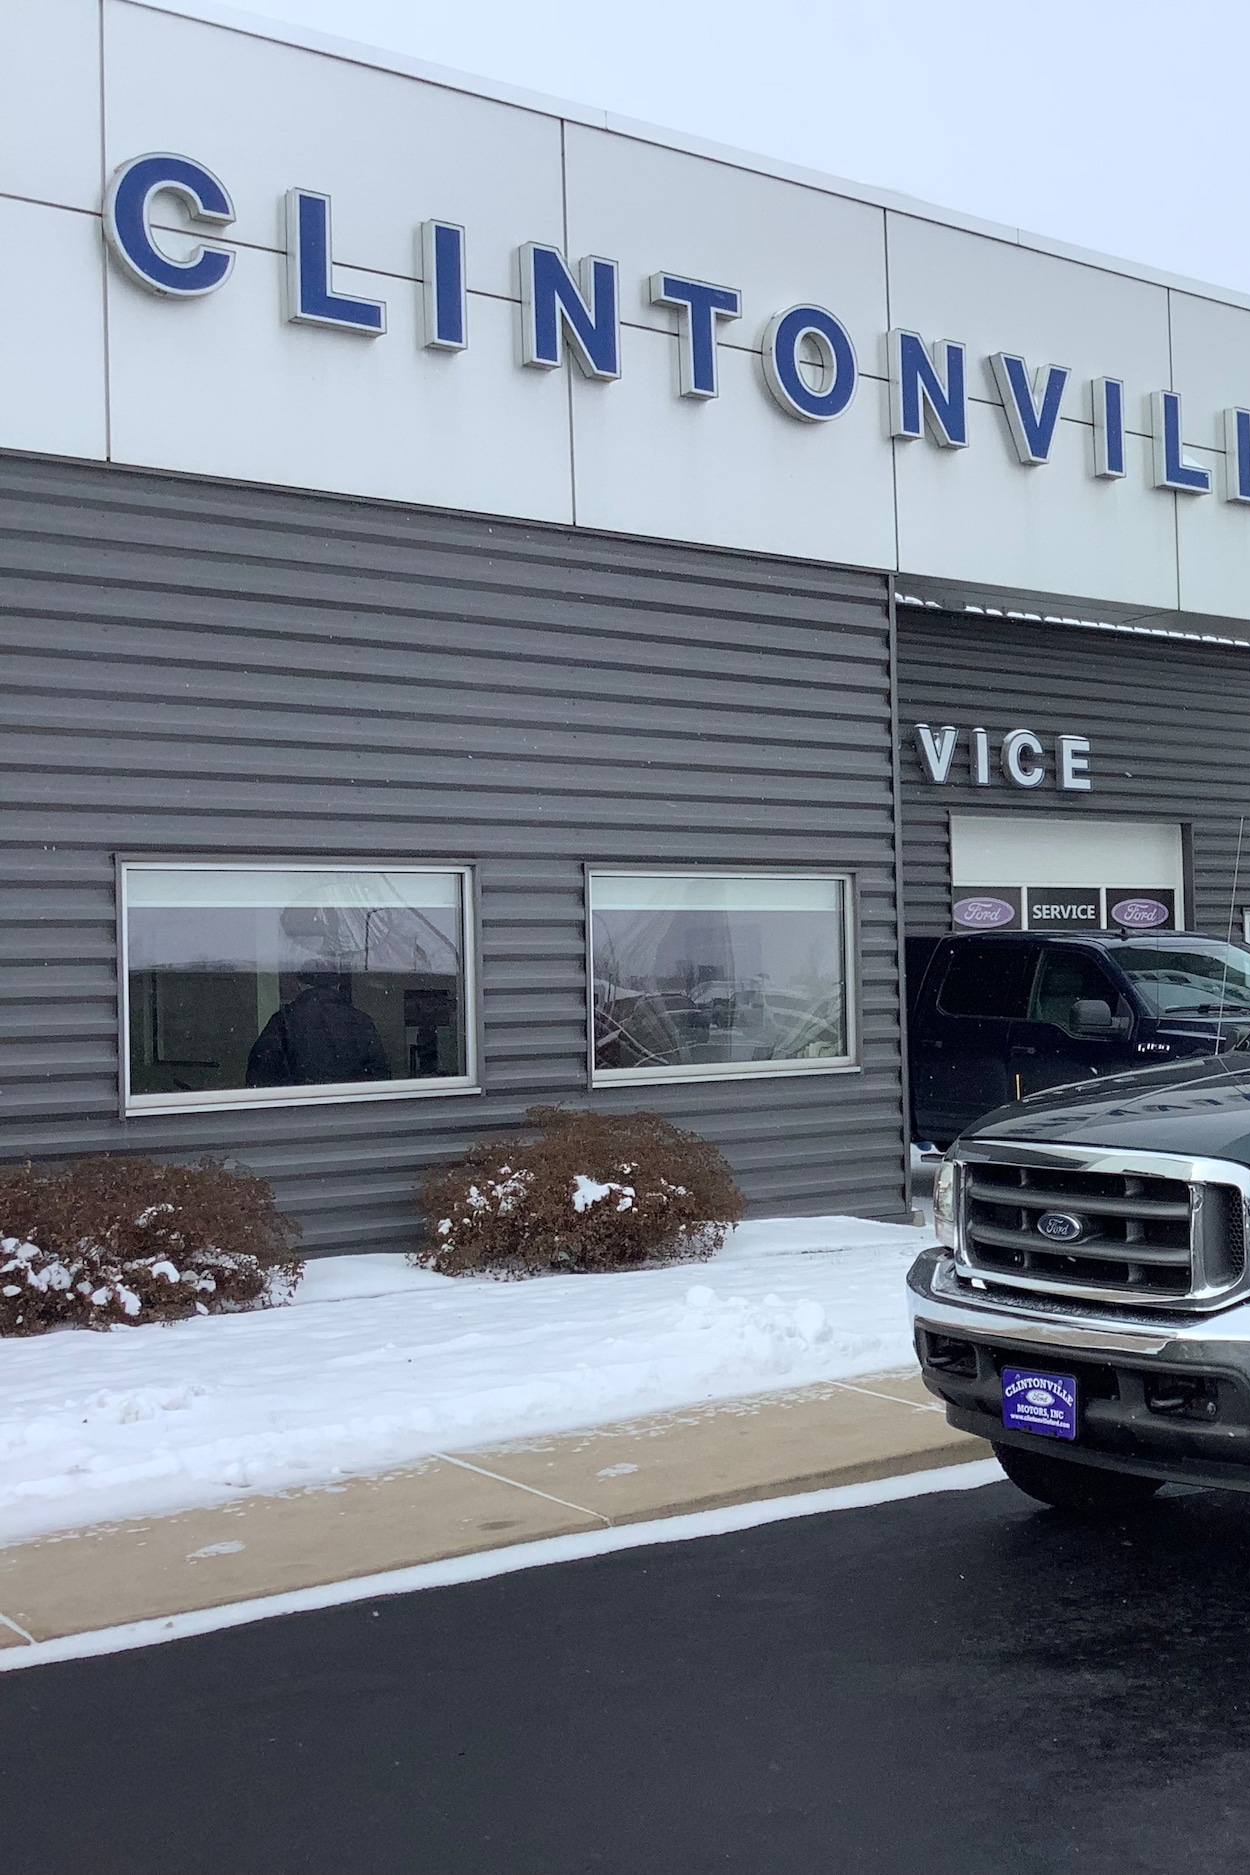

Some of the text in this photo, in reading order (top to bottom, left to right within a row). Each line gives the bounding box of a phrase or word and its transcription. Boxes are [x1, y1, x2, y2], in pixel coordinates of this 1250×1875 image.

[914, 724, 1094, 791] VICE
[1032, 904, 1096, 920] SERVICE
[1046, 1218, 1070, 1236] Ford
[1005, 1377, 1074, 1407] CLINTONVILLE
[1016, 1403, 1065, 1420] MOTORS, INC
